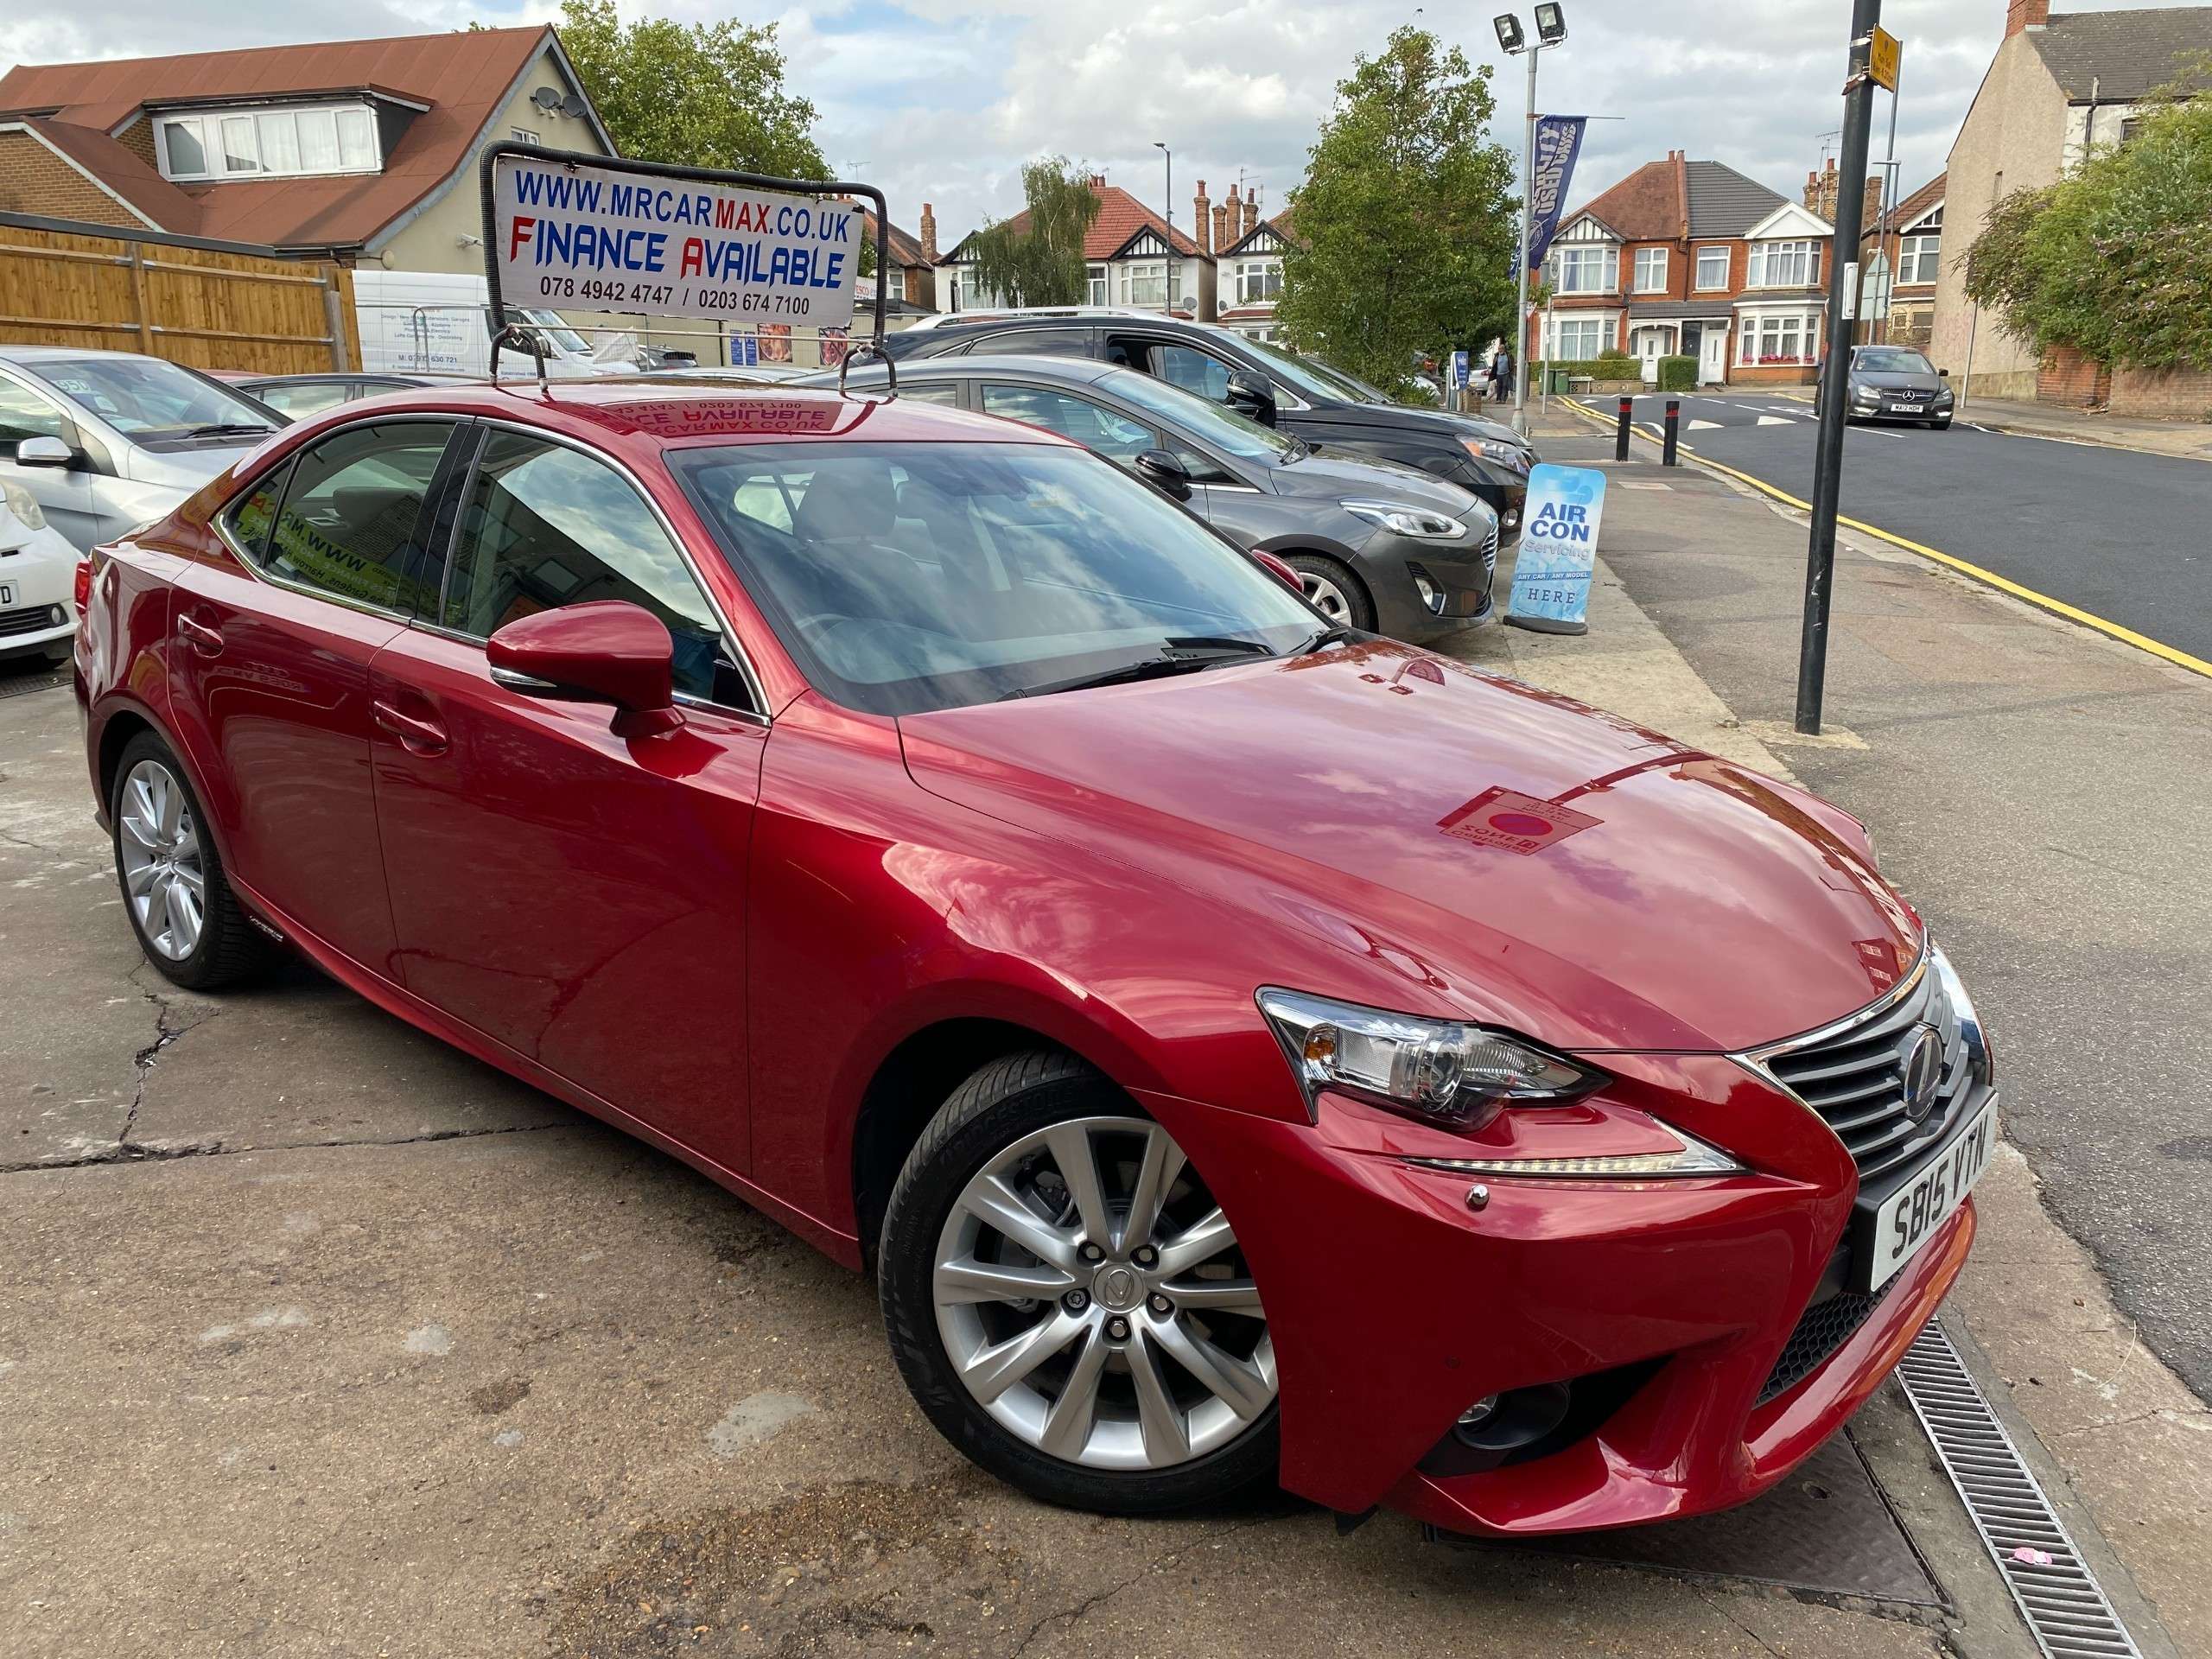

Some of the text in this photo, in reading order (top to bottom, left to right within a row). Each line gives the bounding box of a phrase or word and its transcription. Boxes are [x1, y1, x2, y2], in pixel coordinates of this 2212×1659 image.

[1538, 167, 1564, 214] USED
[515, 170, 850, 243] WWW.MRCARMAX.CO.UK
[510, 216, 846, 290] FINANCE AVAILABLE
[540, 276, 575, 297] 078
[581, 279, 625, 303] 4942
[631, 284, 673, 305] 4747
[699, 289, 737, 309] 0203
[743, 293, 770, 313] 674
[775, 296, 810, 315] 7100
[855, 284, 869, 296] ESCO
[1537, 502, 1586, 524] AIR
[1529, 519, 1590, 543] CON
[1524, 539, 1591, 561] Servicing
[1528, 588, 1577, 604] HERE
[1892, 1113, 1990, 1260] SB15 VTN
